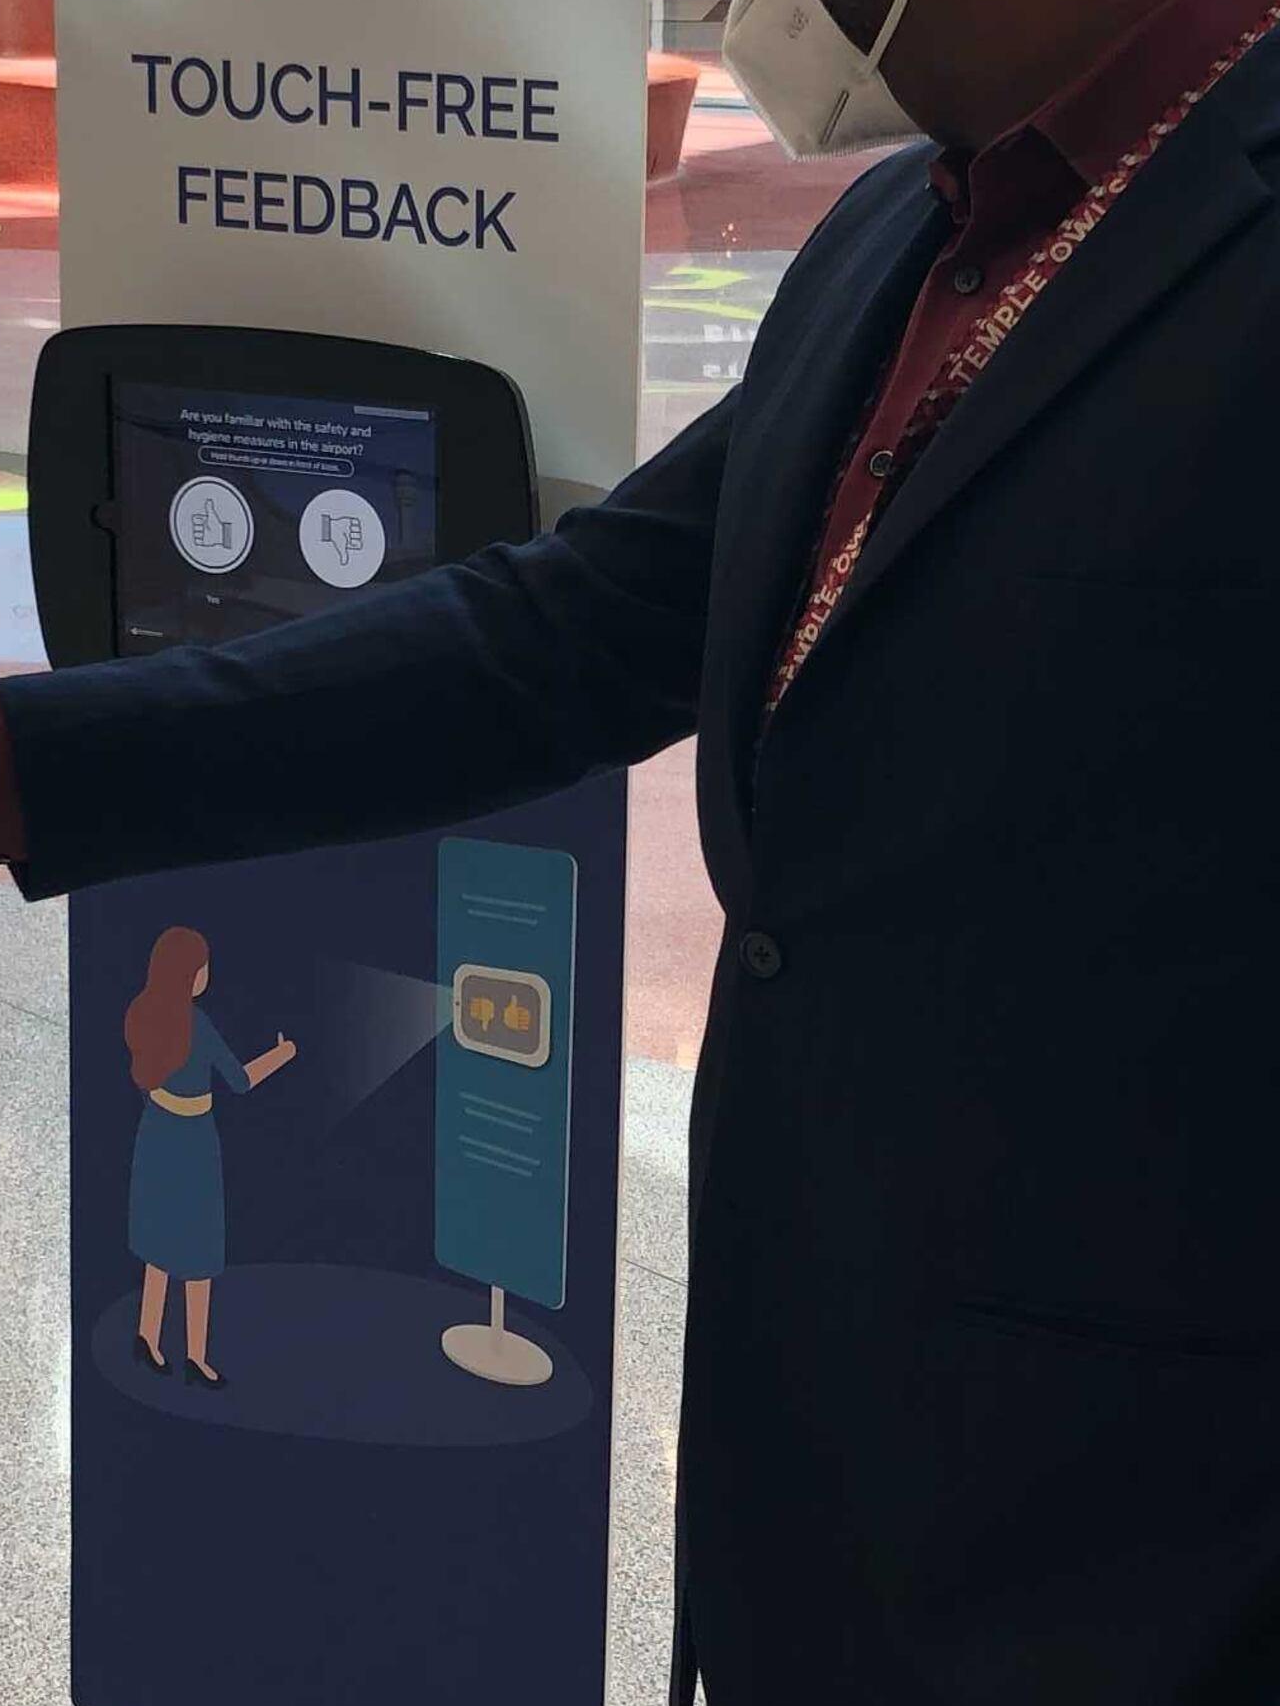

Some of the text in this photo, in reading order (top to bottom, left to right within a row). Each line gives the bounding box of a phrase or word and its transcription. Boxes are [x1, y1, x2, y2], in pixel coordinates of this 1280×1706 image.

[130, 52, 560, 144] TOUCH-FREE
[177, 165, 518, 254] FEEDBACK
[948, 269, 1048, 384] TEMPLE
[180, 409, 372, 438] Are you familiar with the safety and
[188, 428, 365, 457] hygiene measures in the airport?
